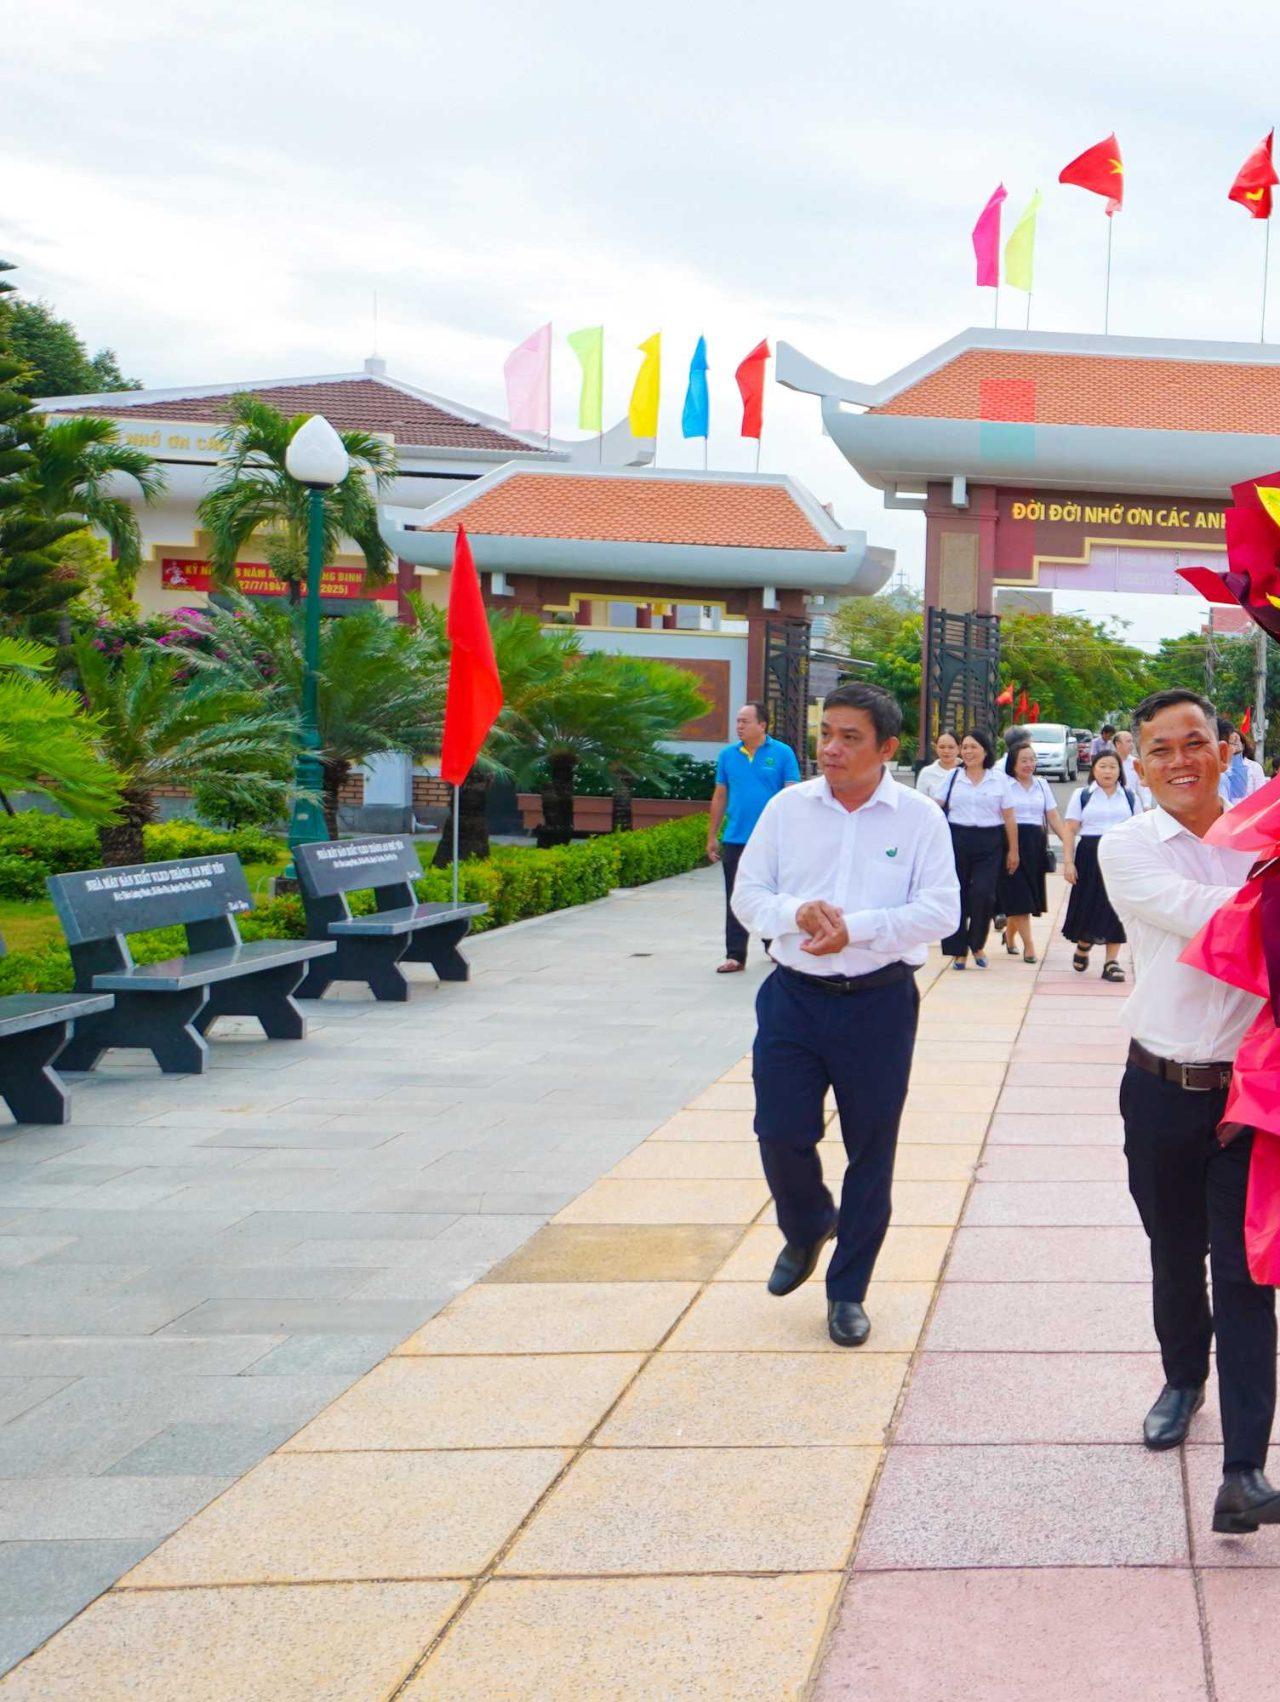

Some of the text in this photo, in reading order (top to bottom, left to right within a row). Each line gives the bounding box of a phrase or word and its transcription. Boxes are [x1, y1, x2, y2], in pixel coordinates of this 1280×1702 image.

[1012, 499, 1046, 521] ĐỜI
[1049, 501, 1082, 522] ĐỜI
[1084, 503, 1125, 525] NHỚ
[1127, 506, 1153, 526] ƠN
[1156, 506, 1191, 528] CÁC
